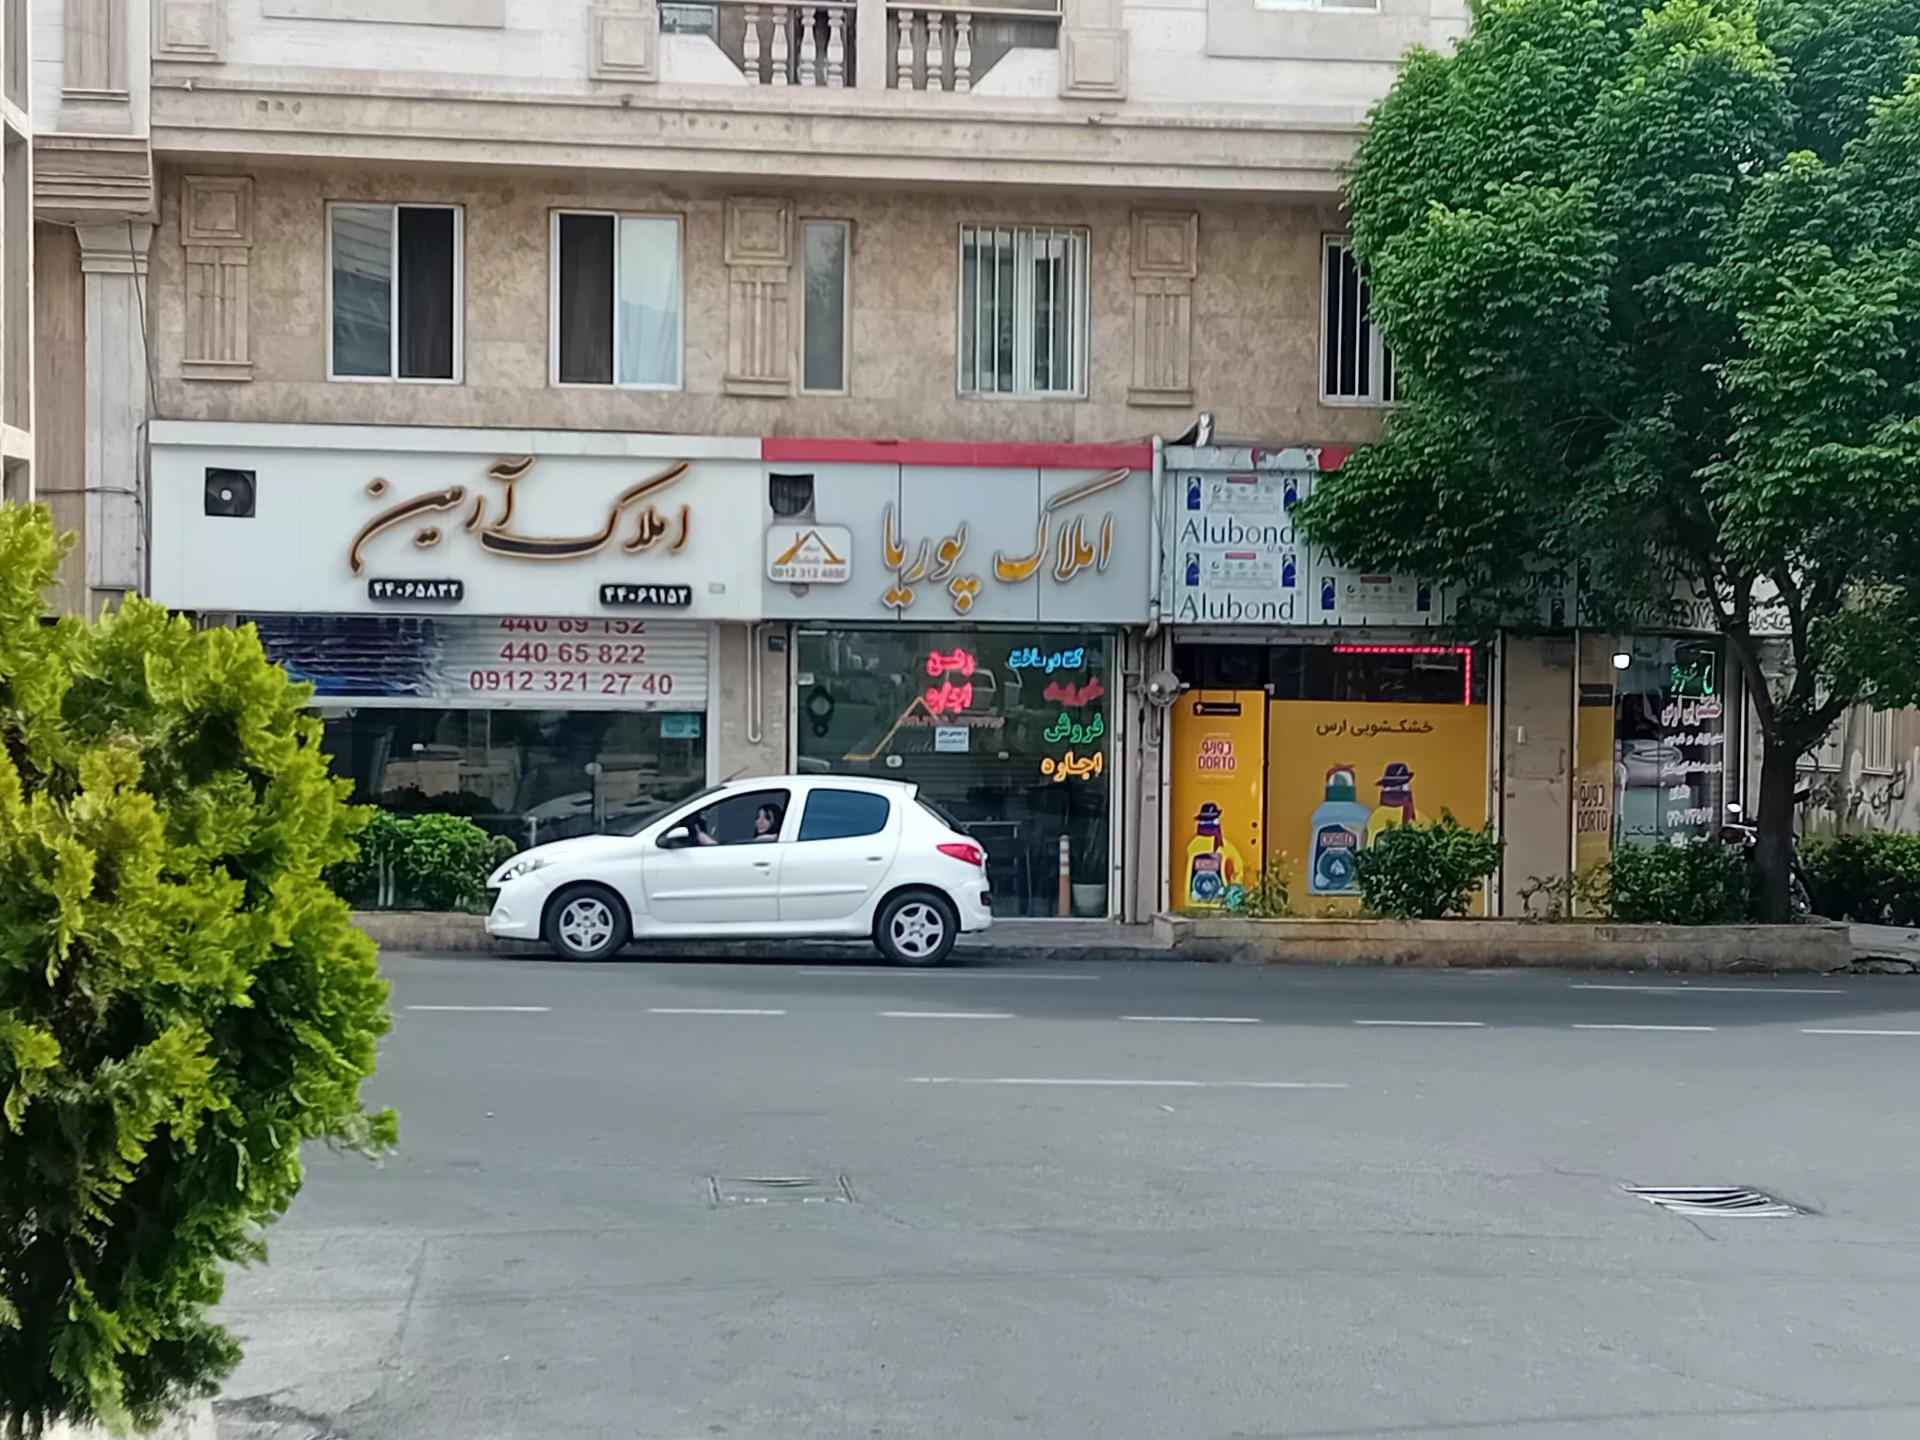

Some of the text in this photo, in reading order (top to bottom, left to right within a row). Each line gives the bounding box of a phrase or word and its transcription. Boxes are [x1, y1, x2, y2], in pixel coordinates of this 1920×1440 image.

[349, 454, 690, 575] املاک آرین
[881, 466, 1131, 615] املاک پوریا
[1180, 515, 1296, 545] Alubond
[1178, 592, 1295, 622] Alubond
[500, 642, 646, 665] 440 65 822
[469, 670, 673, 695] 0912 321 27 40
[1043, 712, 1104, 743] فروش
[1316, 718, 1434, 738] خشکشویی ارس
[1040, 750, 1103, 782] اجاره
[1198, 755, 1236, 770] DORTO
